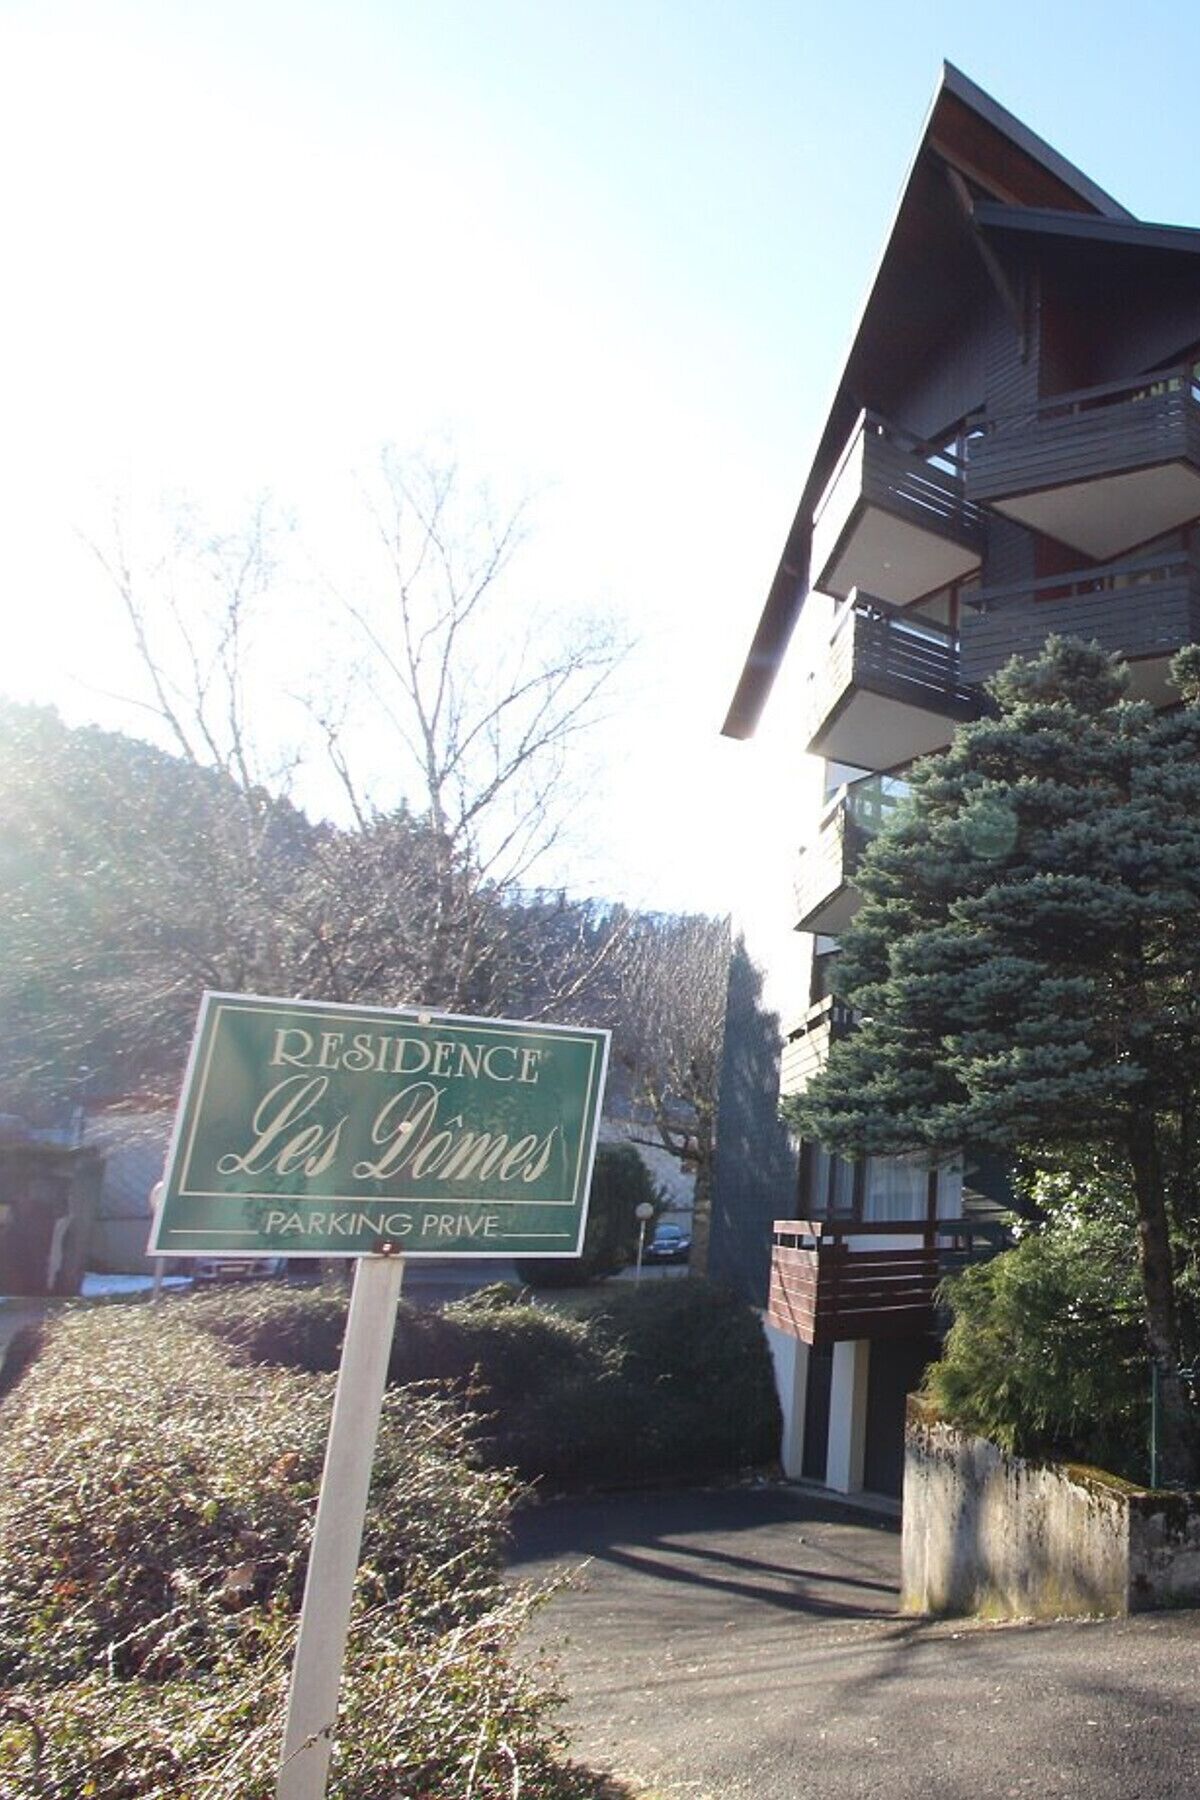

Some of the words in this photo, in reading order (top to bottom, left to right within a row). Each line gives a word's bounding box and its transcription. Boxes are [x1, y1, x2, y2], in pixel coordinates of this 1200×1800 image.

[269, 1028, 541, 1083] RESIDENCE
[217, 1074, 349, 1177] Les
[353, 1081, 559, 1183] Dômes
[265, 1211, 413, 1236] PARKING
[422, 1213, 500, 1238] PRIVE
